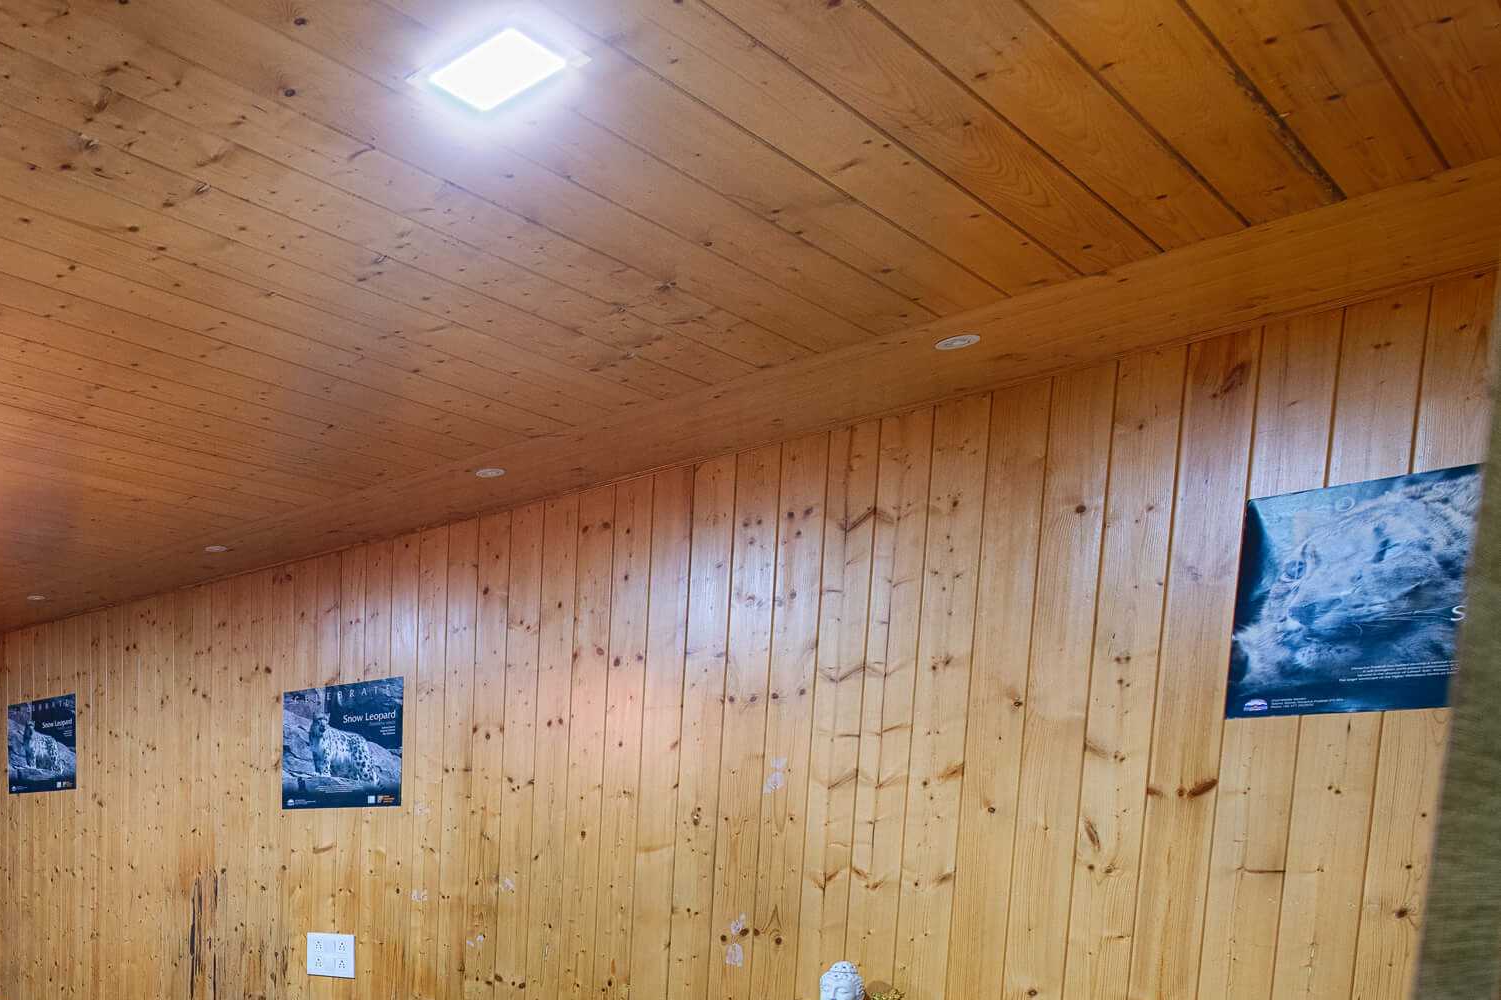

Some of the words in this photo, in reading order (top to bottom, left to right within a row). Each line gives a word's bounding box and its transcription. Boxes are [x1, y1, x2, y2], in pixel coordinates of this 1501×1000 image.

[292, 684, 391, 704] CELEBRATE
[343, 714, 363, 723] Snow
[365, 710, 396, 721] Leopard
